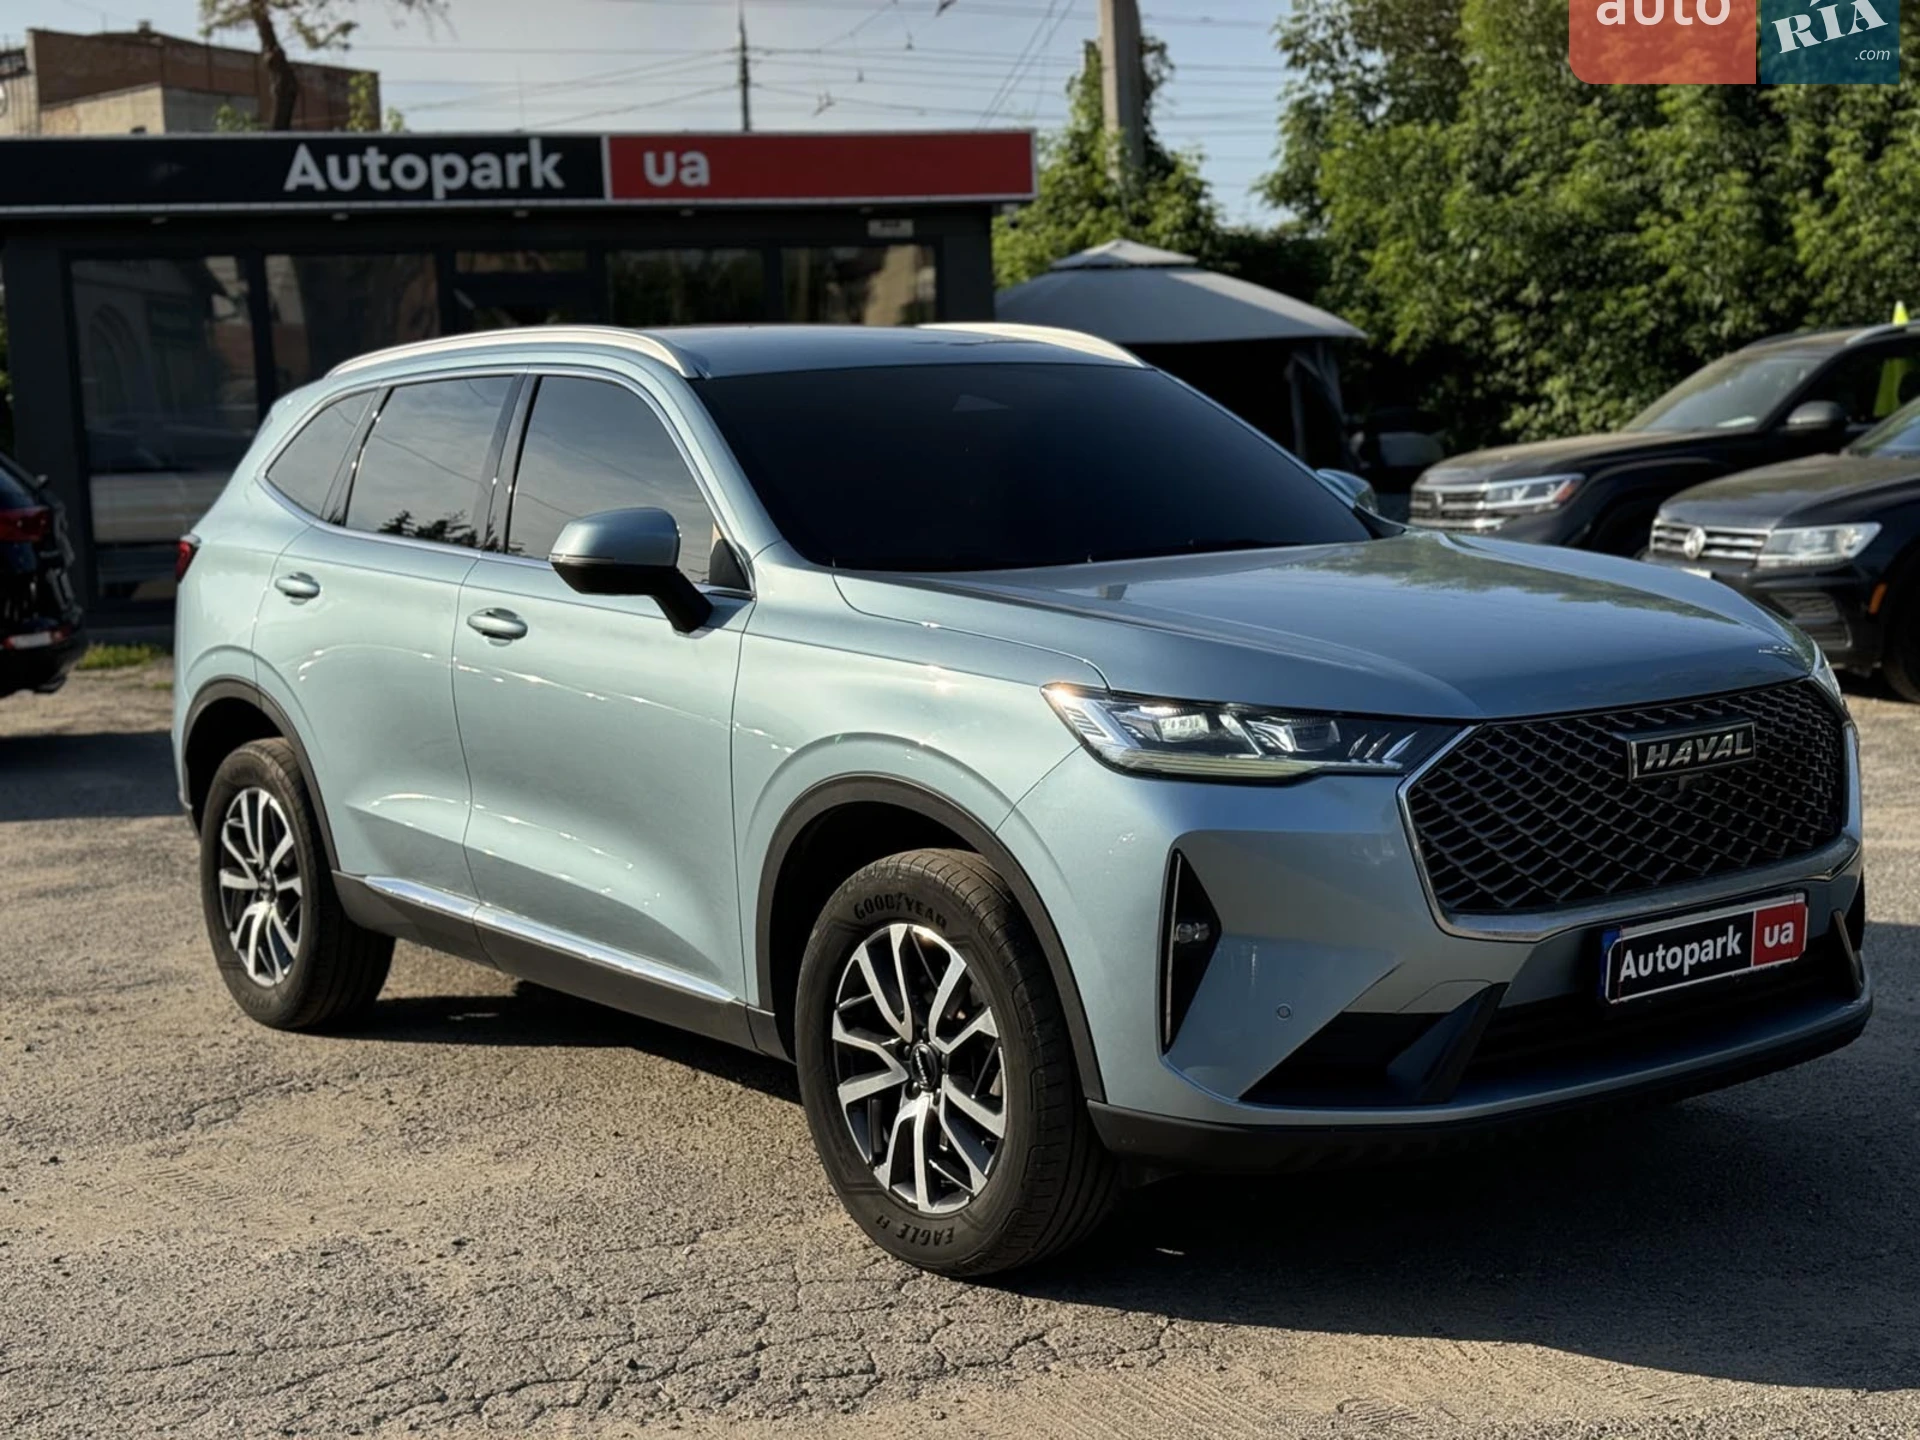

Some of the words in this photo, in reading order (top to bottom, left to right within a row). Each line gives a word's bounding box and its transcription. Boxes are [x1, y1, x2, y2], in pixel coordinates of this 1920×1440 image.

[283, 138, 565, 200] Autopark
[643, 149, 711, 187] ua
[1643, 731, 1752, 770] HAVAL
[854, 892, 947, 929] GOODYEAR
[1618, 925, 1742, 983] Autopark
[1763, 921, 1794, 948] ua
[896, 1223, 956, 1247] EAGLE
